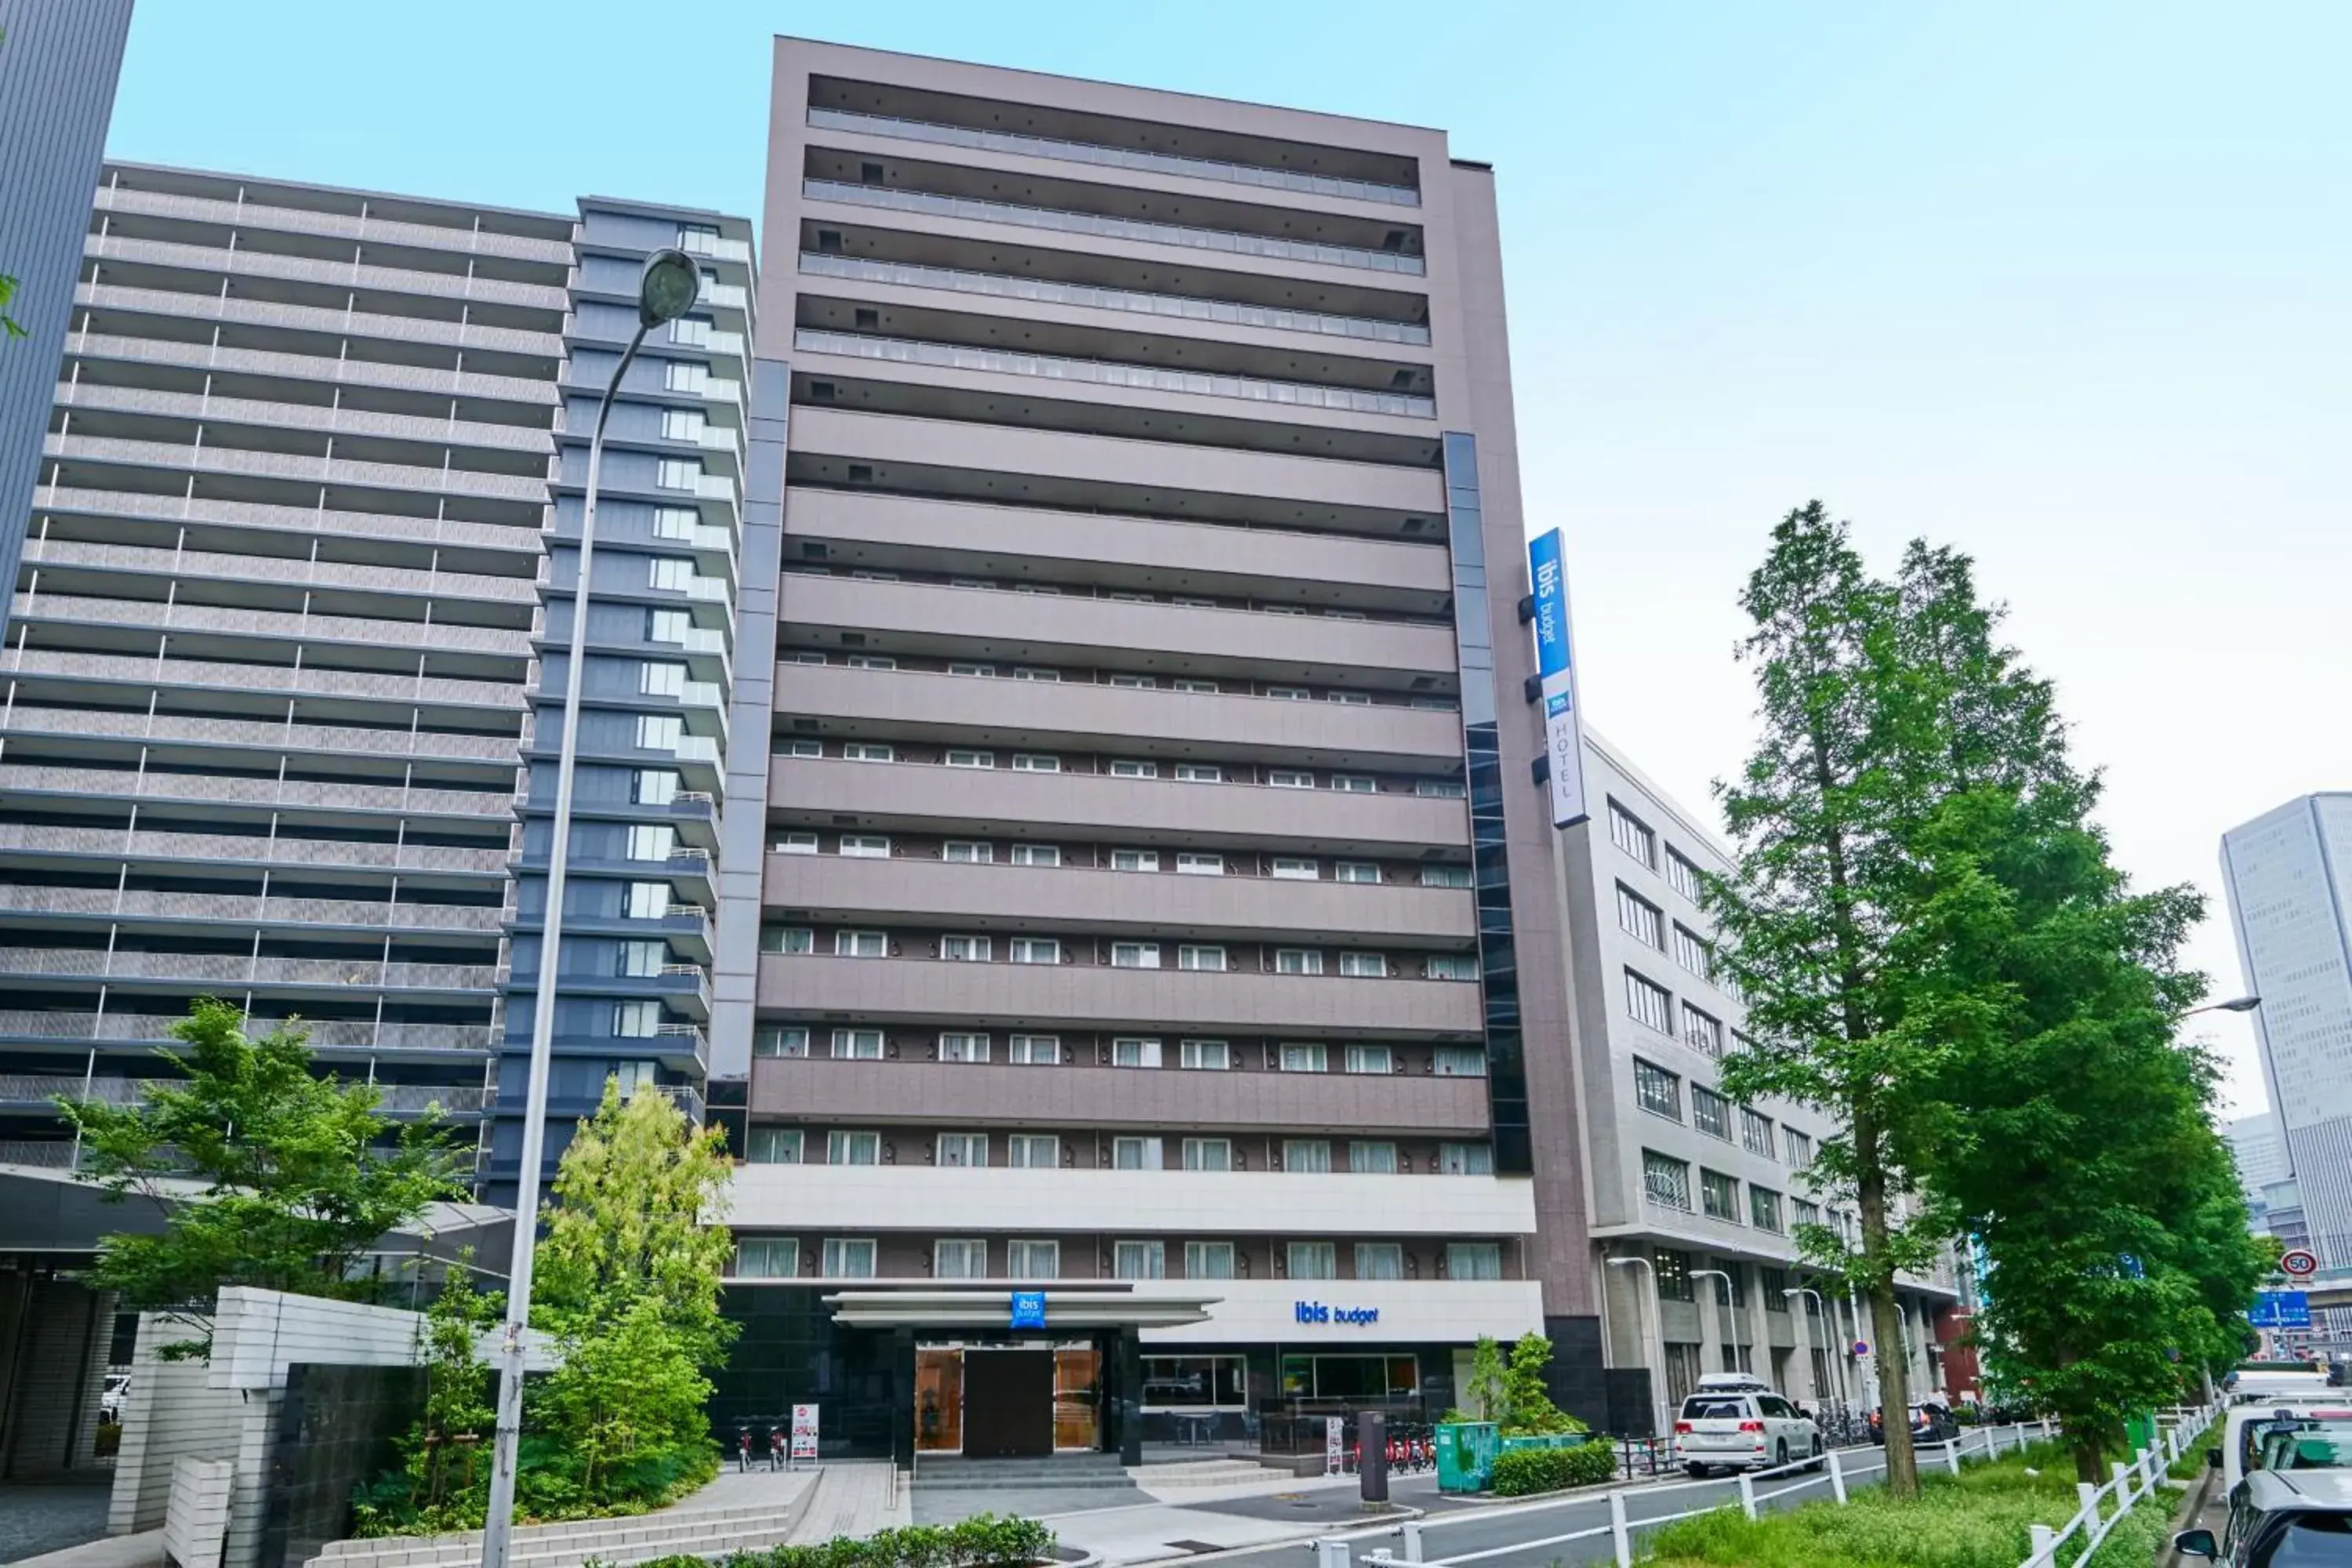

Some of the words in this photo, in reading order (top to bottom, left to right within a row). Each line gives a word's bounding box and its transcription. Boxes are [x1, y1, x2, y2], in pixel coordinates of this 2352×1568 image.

[1537, 558, 1559, 598] ibis
[1540, 602, 1556, 644] budget
[1556, 723, 1571, 798] HOTEL
[2290, 1258, 2309, 1269] 50
[1019, 1297, 1039, 1310] ibis
[1295, 1301, 1329, 1323] ibis
[1334, 1306, 1378, 1327] budget
